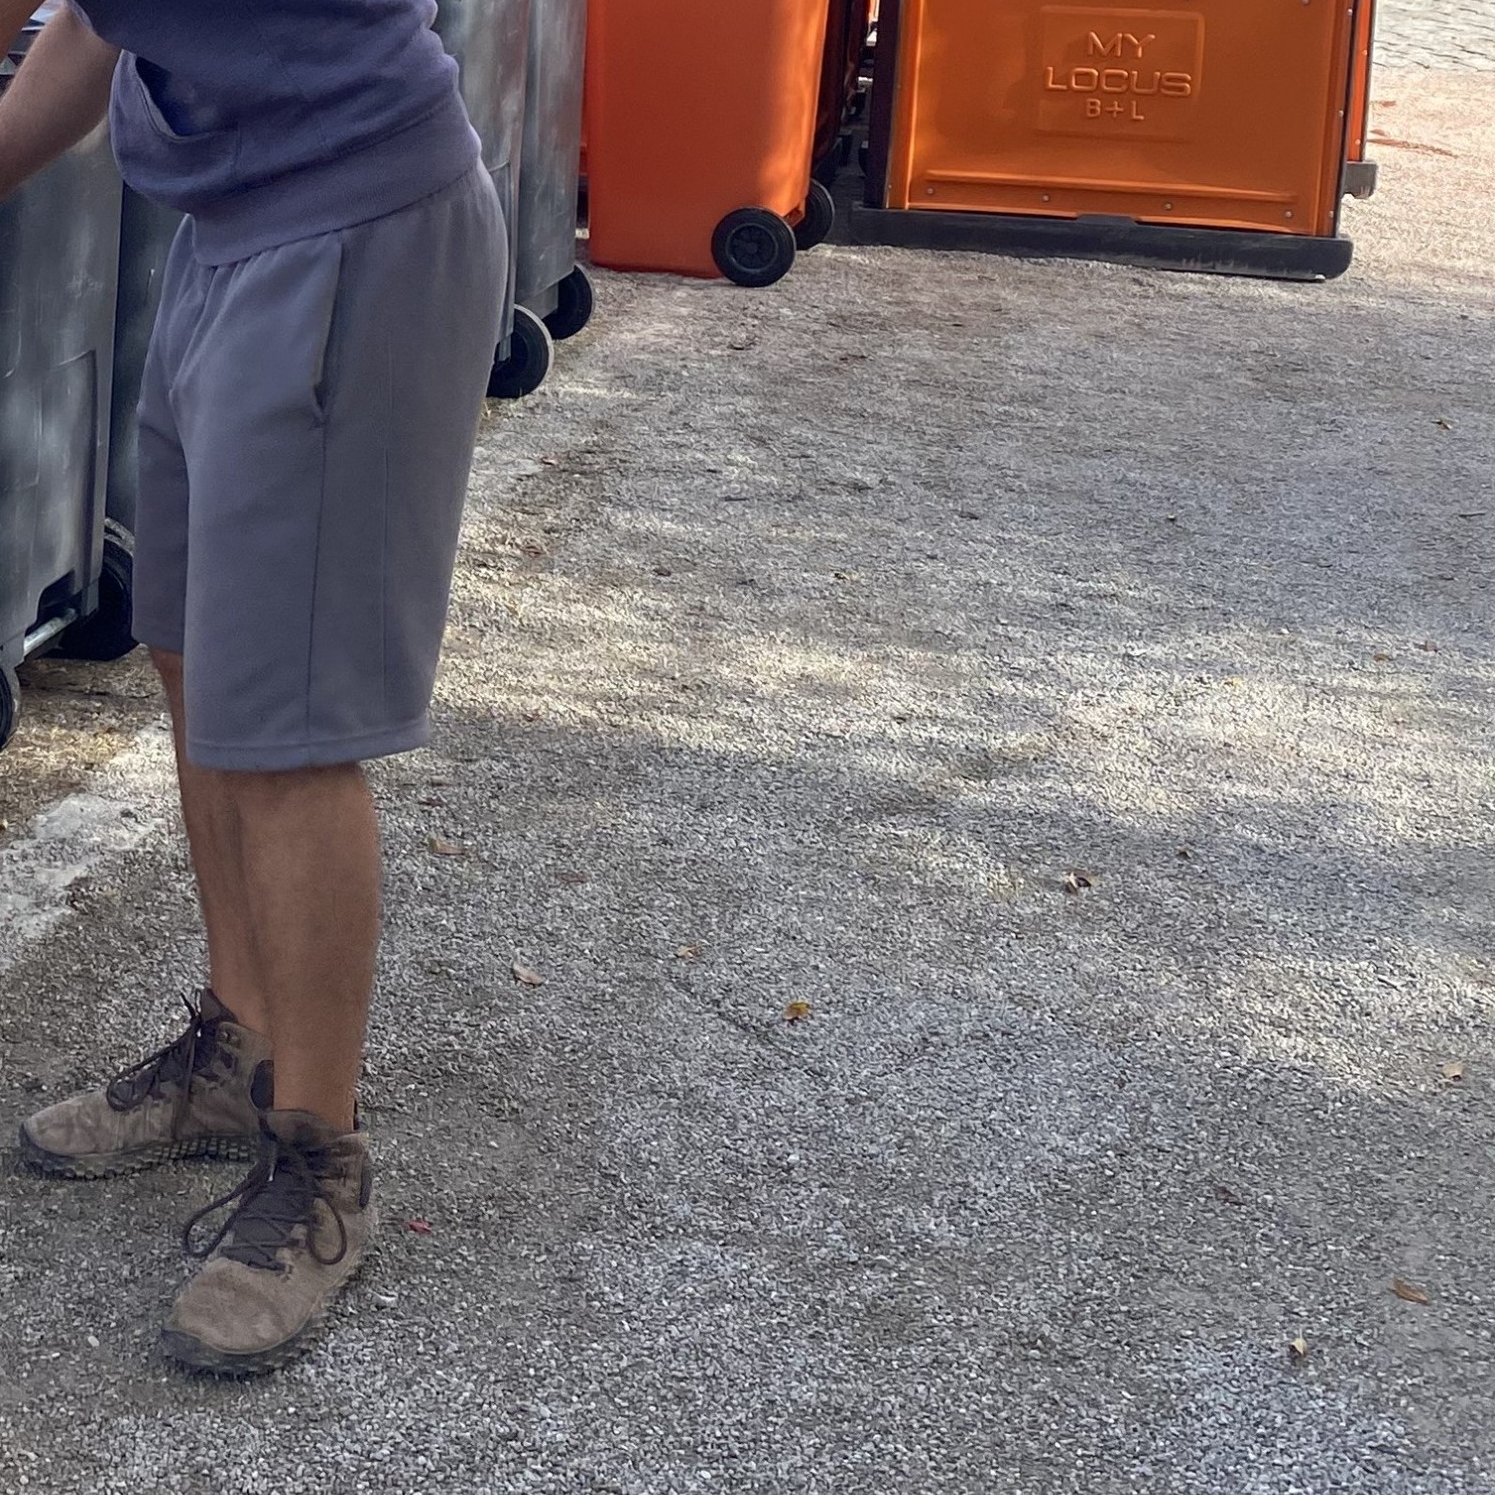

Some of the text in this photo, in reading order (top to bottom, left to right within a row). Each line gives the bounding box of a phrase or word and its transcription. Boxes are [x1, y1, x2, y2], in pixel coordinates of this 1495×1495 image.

[1089, 31, 1156, 58] MY
[1045, 66, 1192, 97] LOCUS
[1085, 97, 1146, 121] B+L
